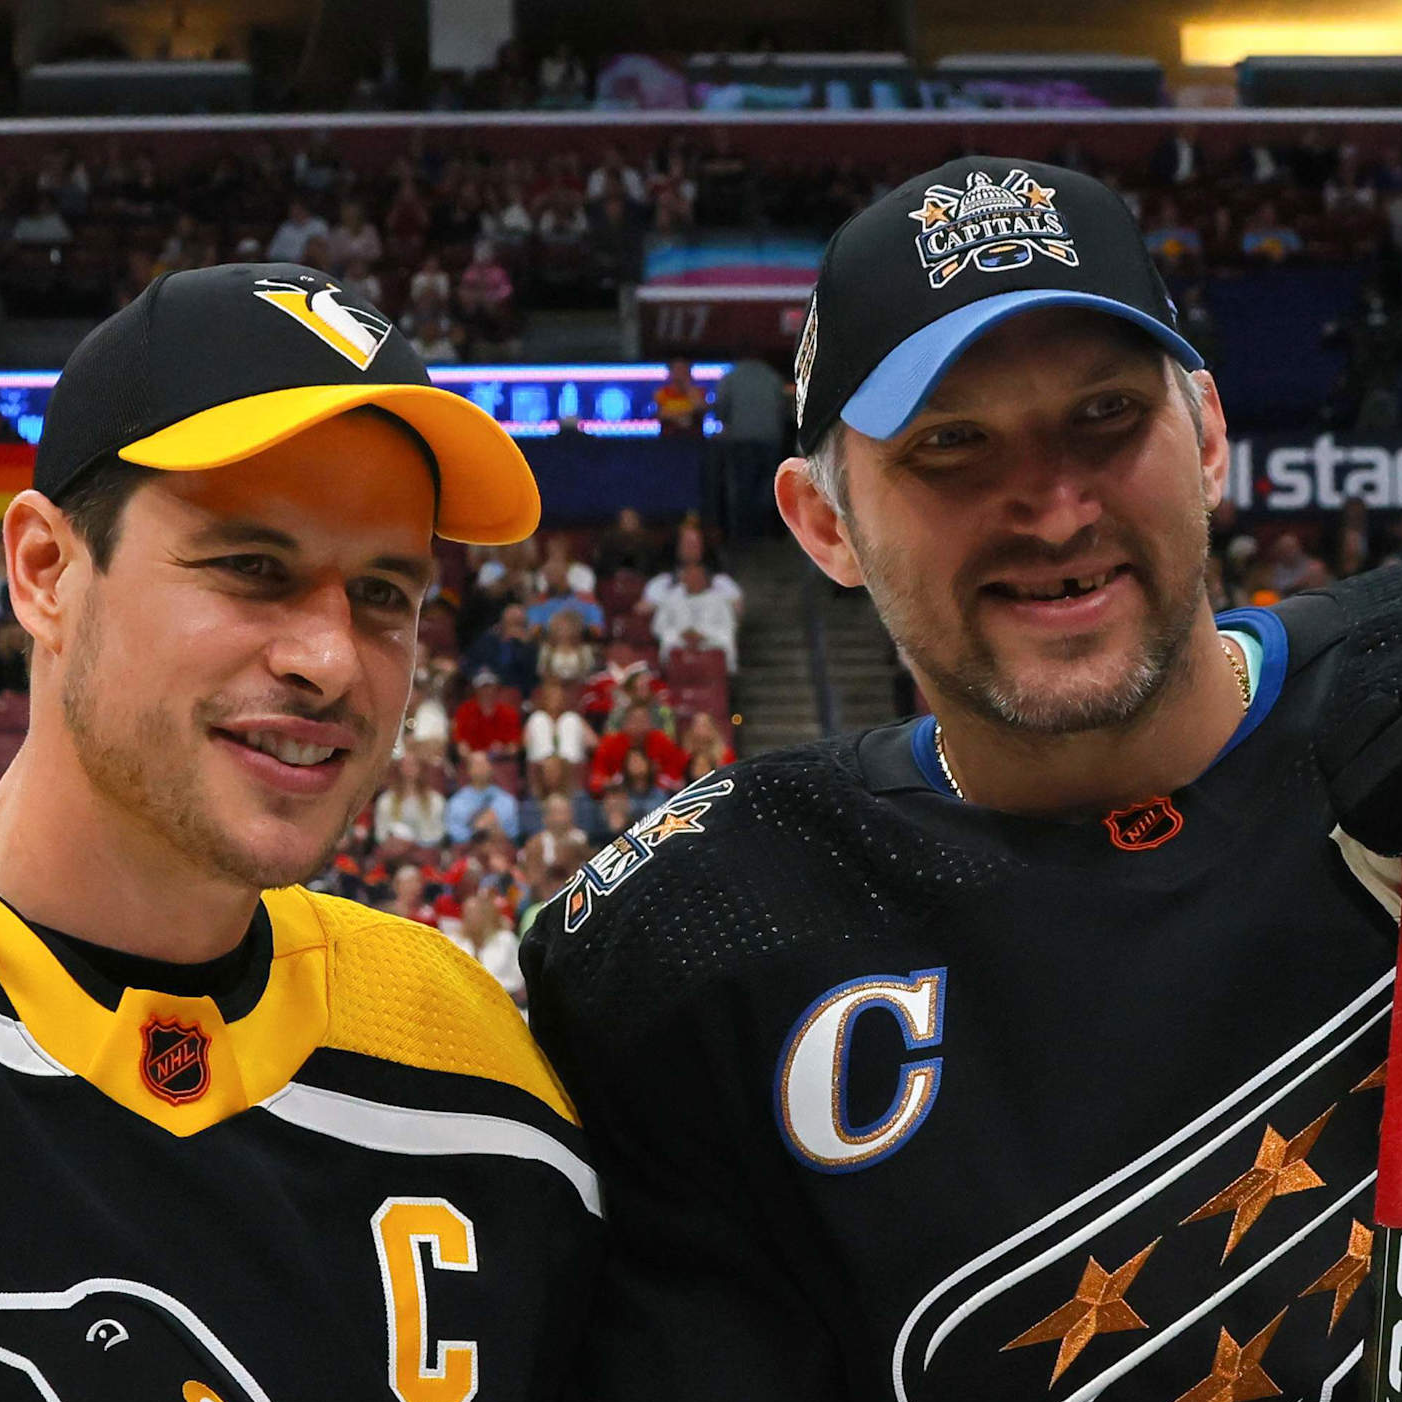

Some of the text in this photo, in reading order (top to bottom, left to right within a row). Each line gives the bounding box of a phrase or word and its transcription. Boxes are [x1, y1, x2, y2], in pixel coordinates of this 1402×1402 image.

[927, 212, 1065, 255] CAPITALS
[156, 1042, 196, 1081] NHL
[773, 966, 948, 1176] C
